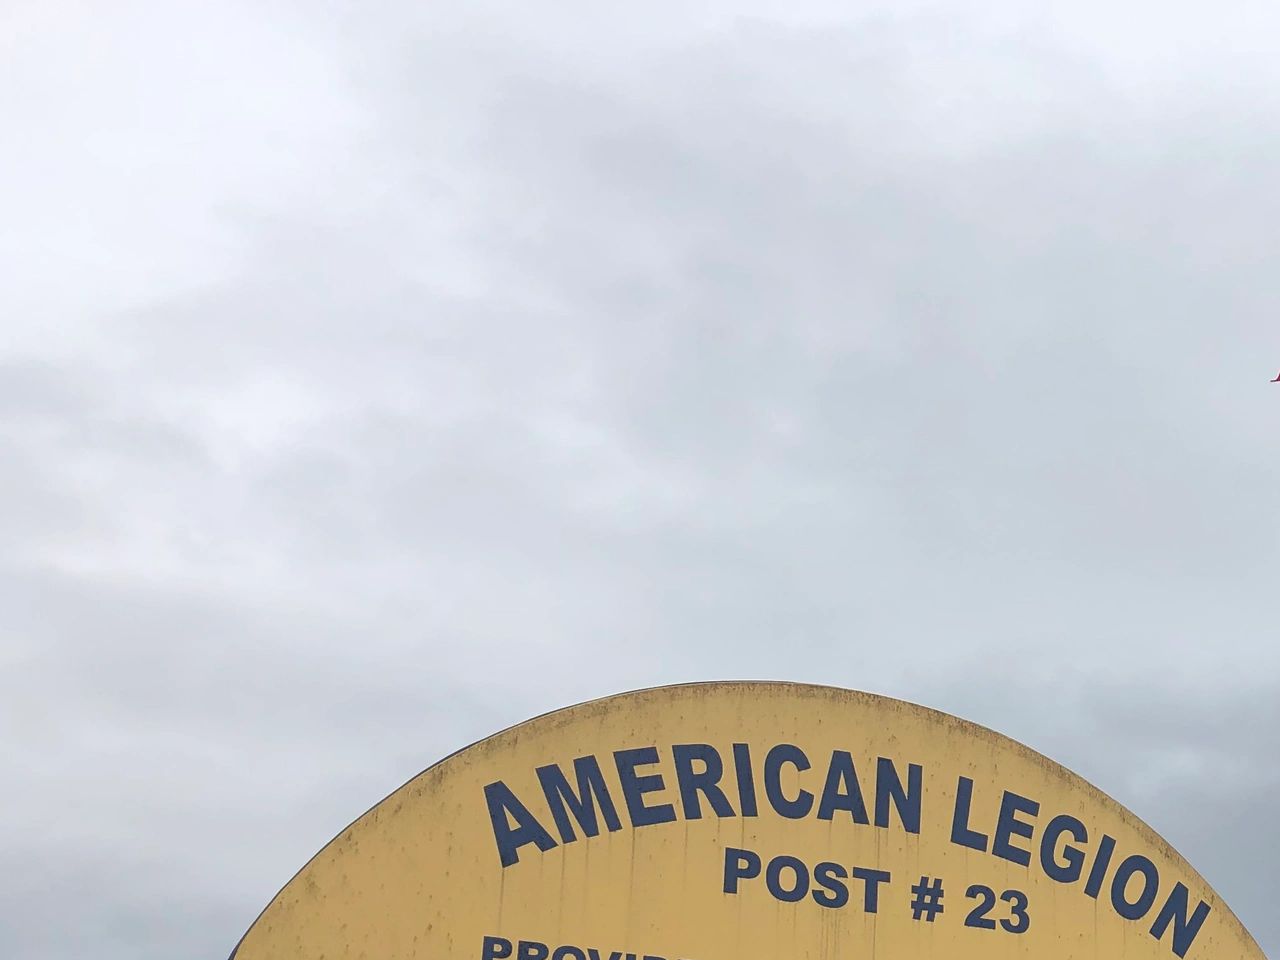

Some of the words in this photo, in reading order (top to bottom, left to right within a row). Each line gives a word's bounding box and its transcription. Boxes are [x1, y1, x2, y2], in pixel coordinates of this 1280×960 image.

[482, 742, 922, 868] AMERICAN
[950, 776, 1211, 958] LEGION
[723, 847, 891, 914] POST
[911, 876, 944, 923] #
[964, 884, 1031, 934] 23
